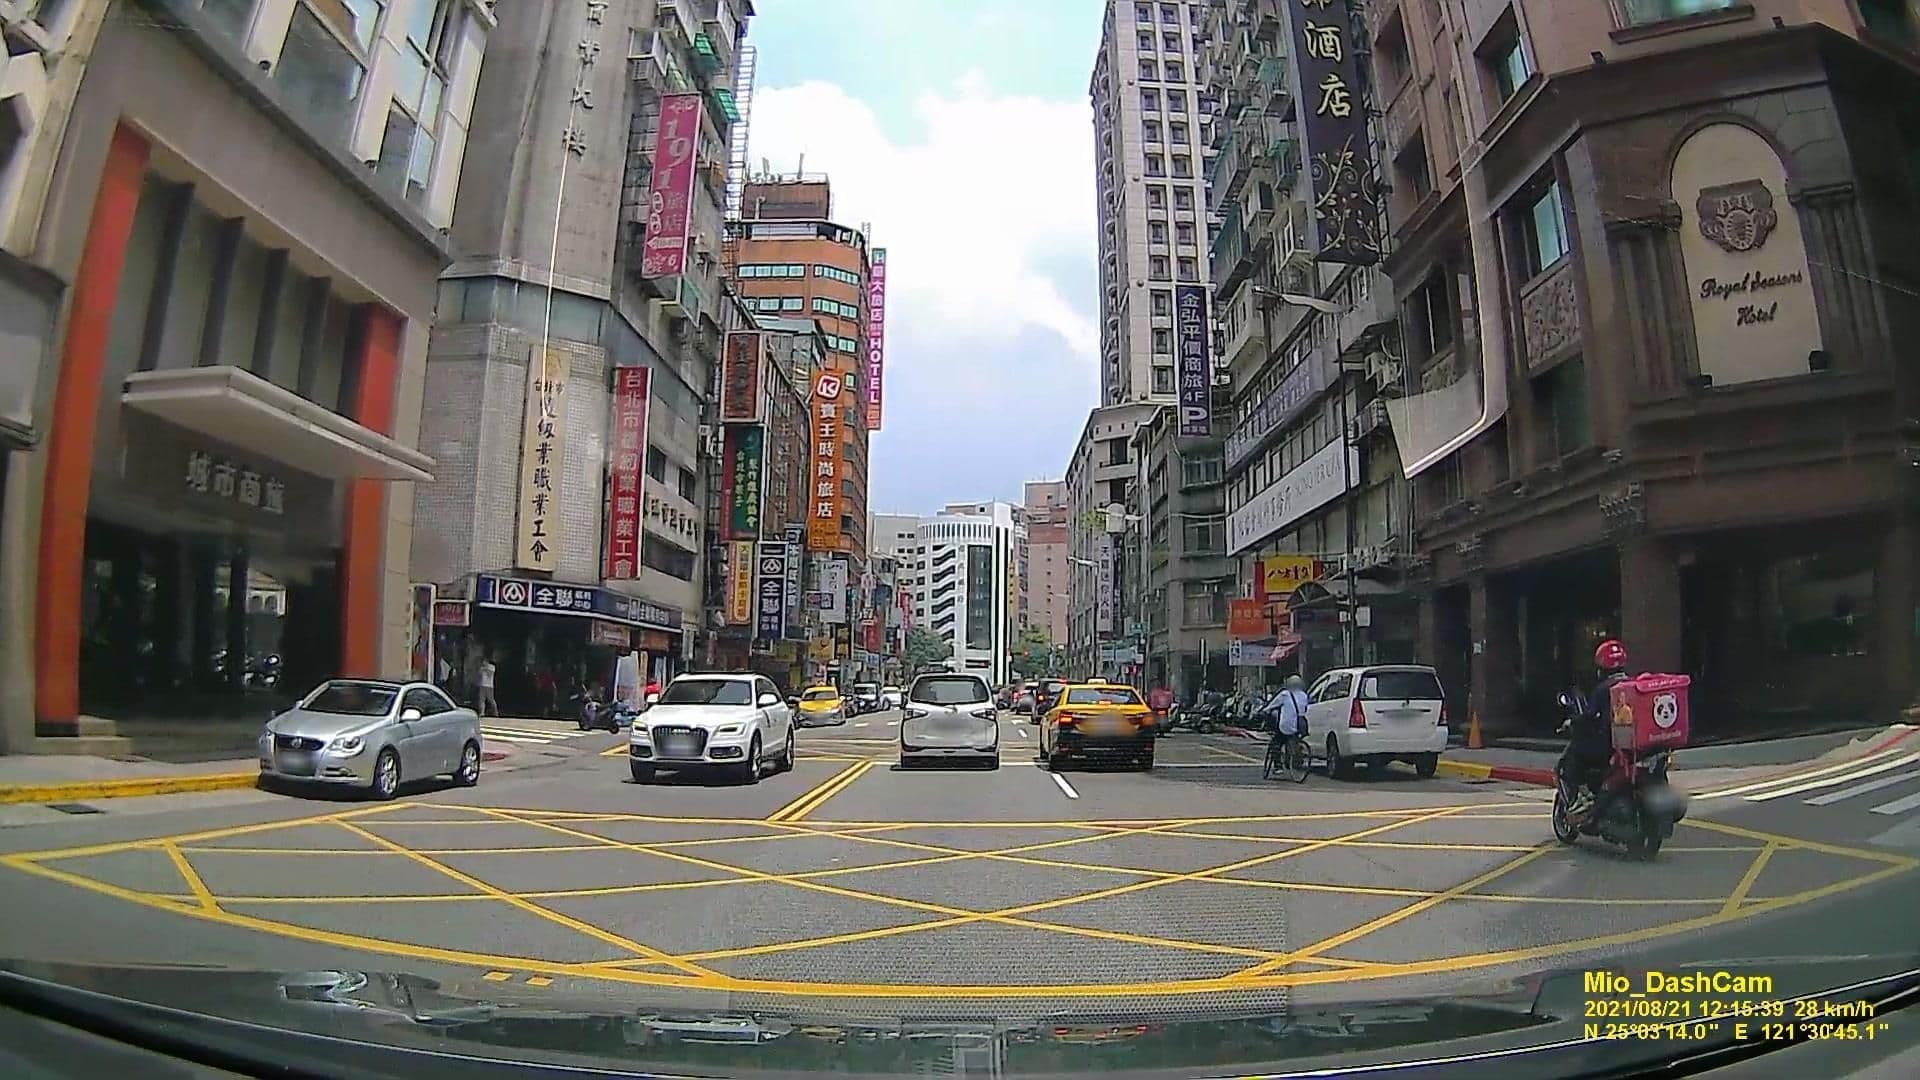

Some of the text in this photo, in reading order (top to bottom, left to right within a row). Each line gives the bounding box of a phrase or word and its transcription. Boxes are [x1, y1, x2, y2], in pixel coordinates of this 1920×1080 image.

[1701, 269, 1803, 299] Royal Seasons
[1737, 302, 1778, 326] Hotel
[870, 337, 882, 403] HOTEL
[1183, 391, 1204, 402] 4F
[1183, 407, 1208, 425] P
[535, 588, 573, 608] 全聯
[761, 580, 780, 614] 全聯
